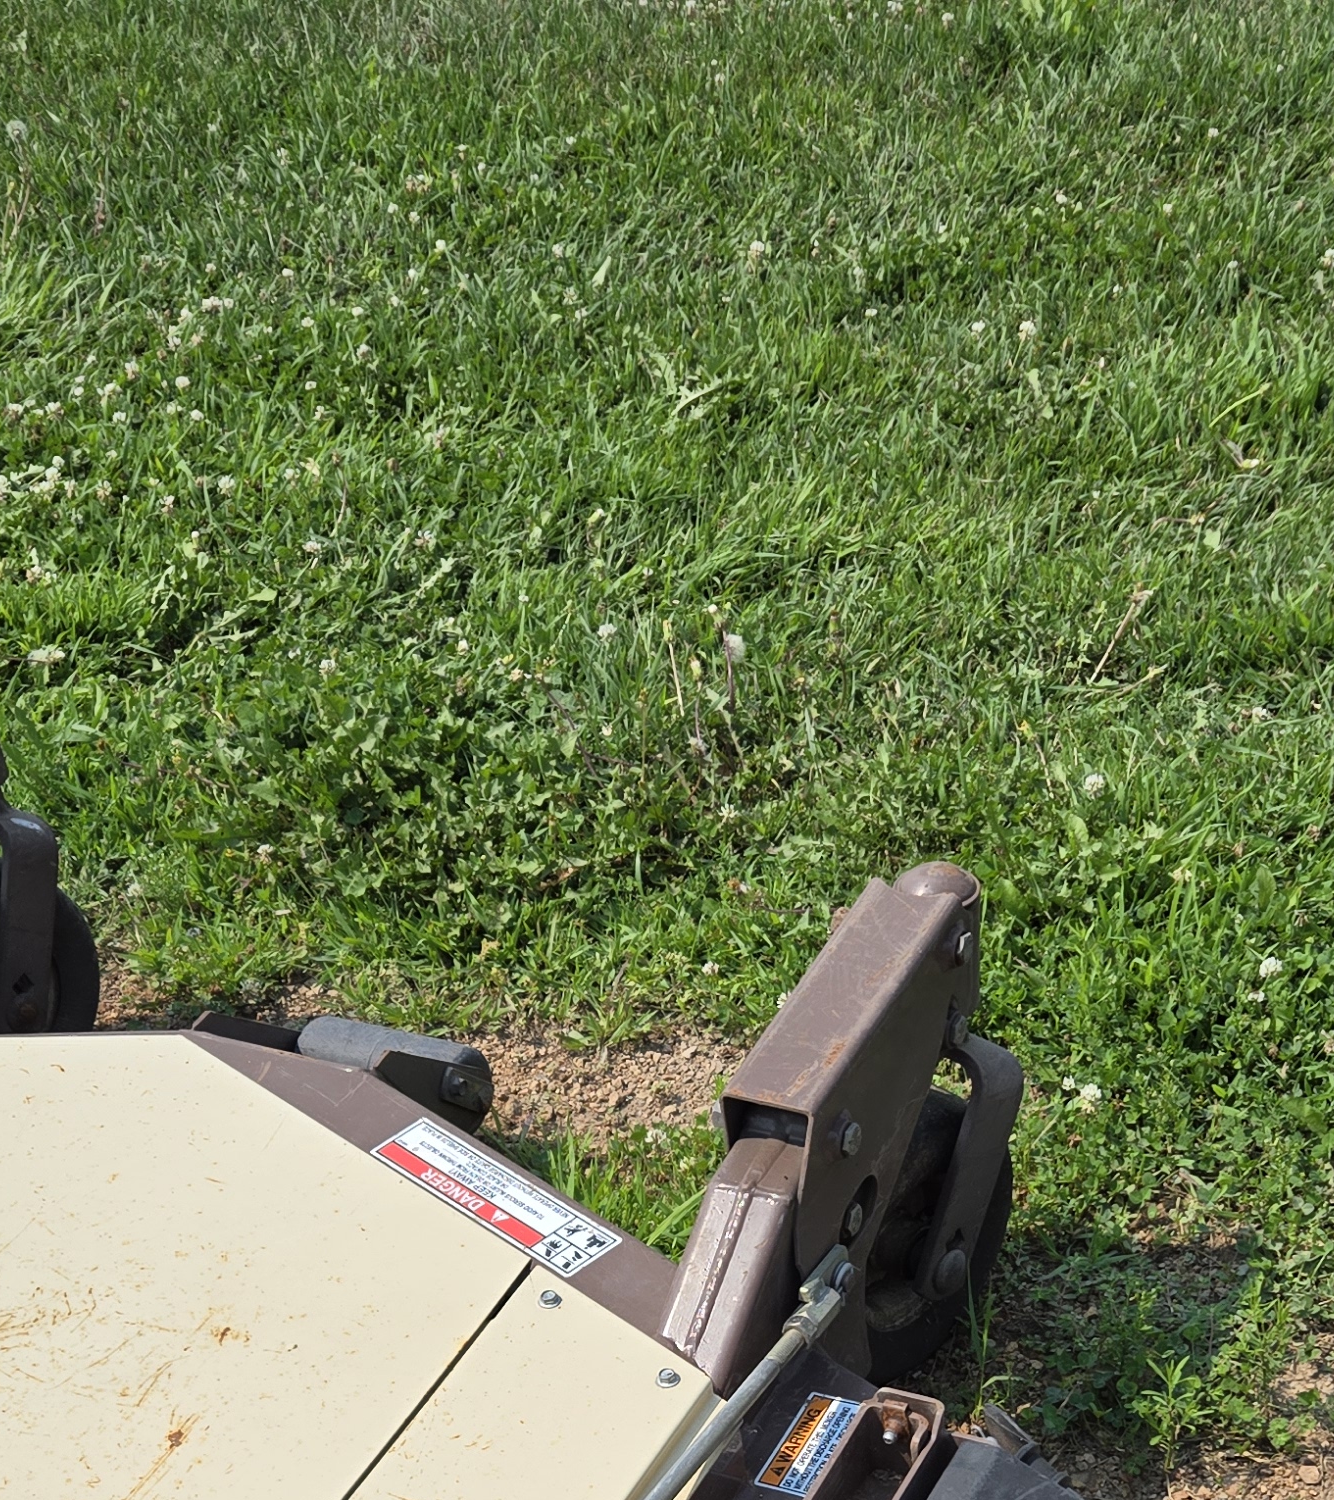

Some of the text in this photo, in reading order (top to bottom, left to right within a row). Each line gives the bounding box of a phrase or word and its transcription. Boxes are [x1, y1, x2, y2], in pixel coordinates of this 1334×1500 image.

[420, 1168, 487, 1211] DANGER
[471, 1183, 497, 1199] KEEP
[779, 1408, 822, 1463] WARNING
[792, 1406, 852, 1489] WITHOUT THE DISCHARGE OPENING
[782, 1478, 793, 1487] DO
[788, 1466, 801, 1478] NOT
[795, 1442, 817, 1466] OPERATE
